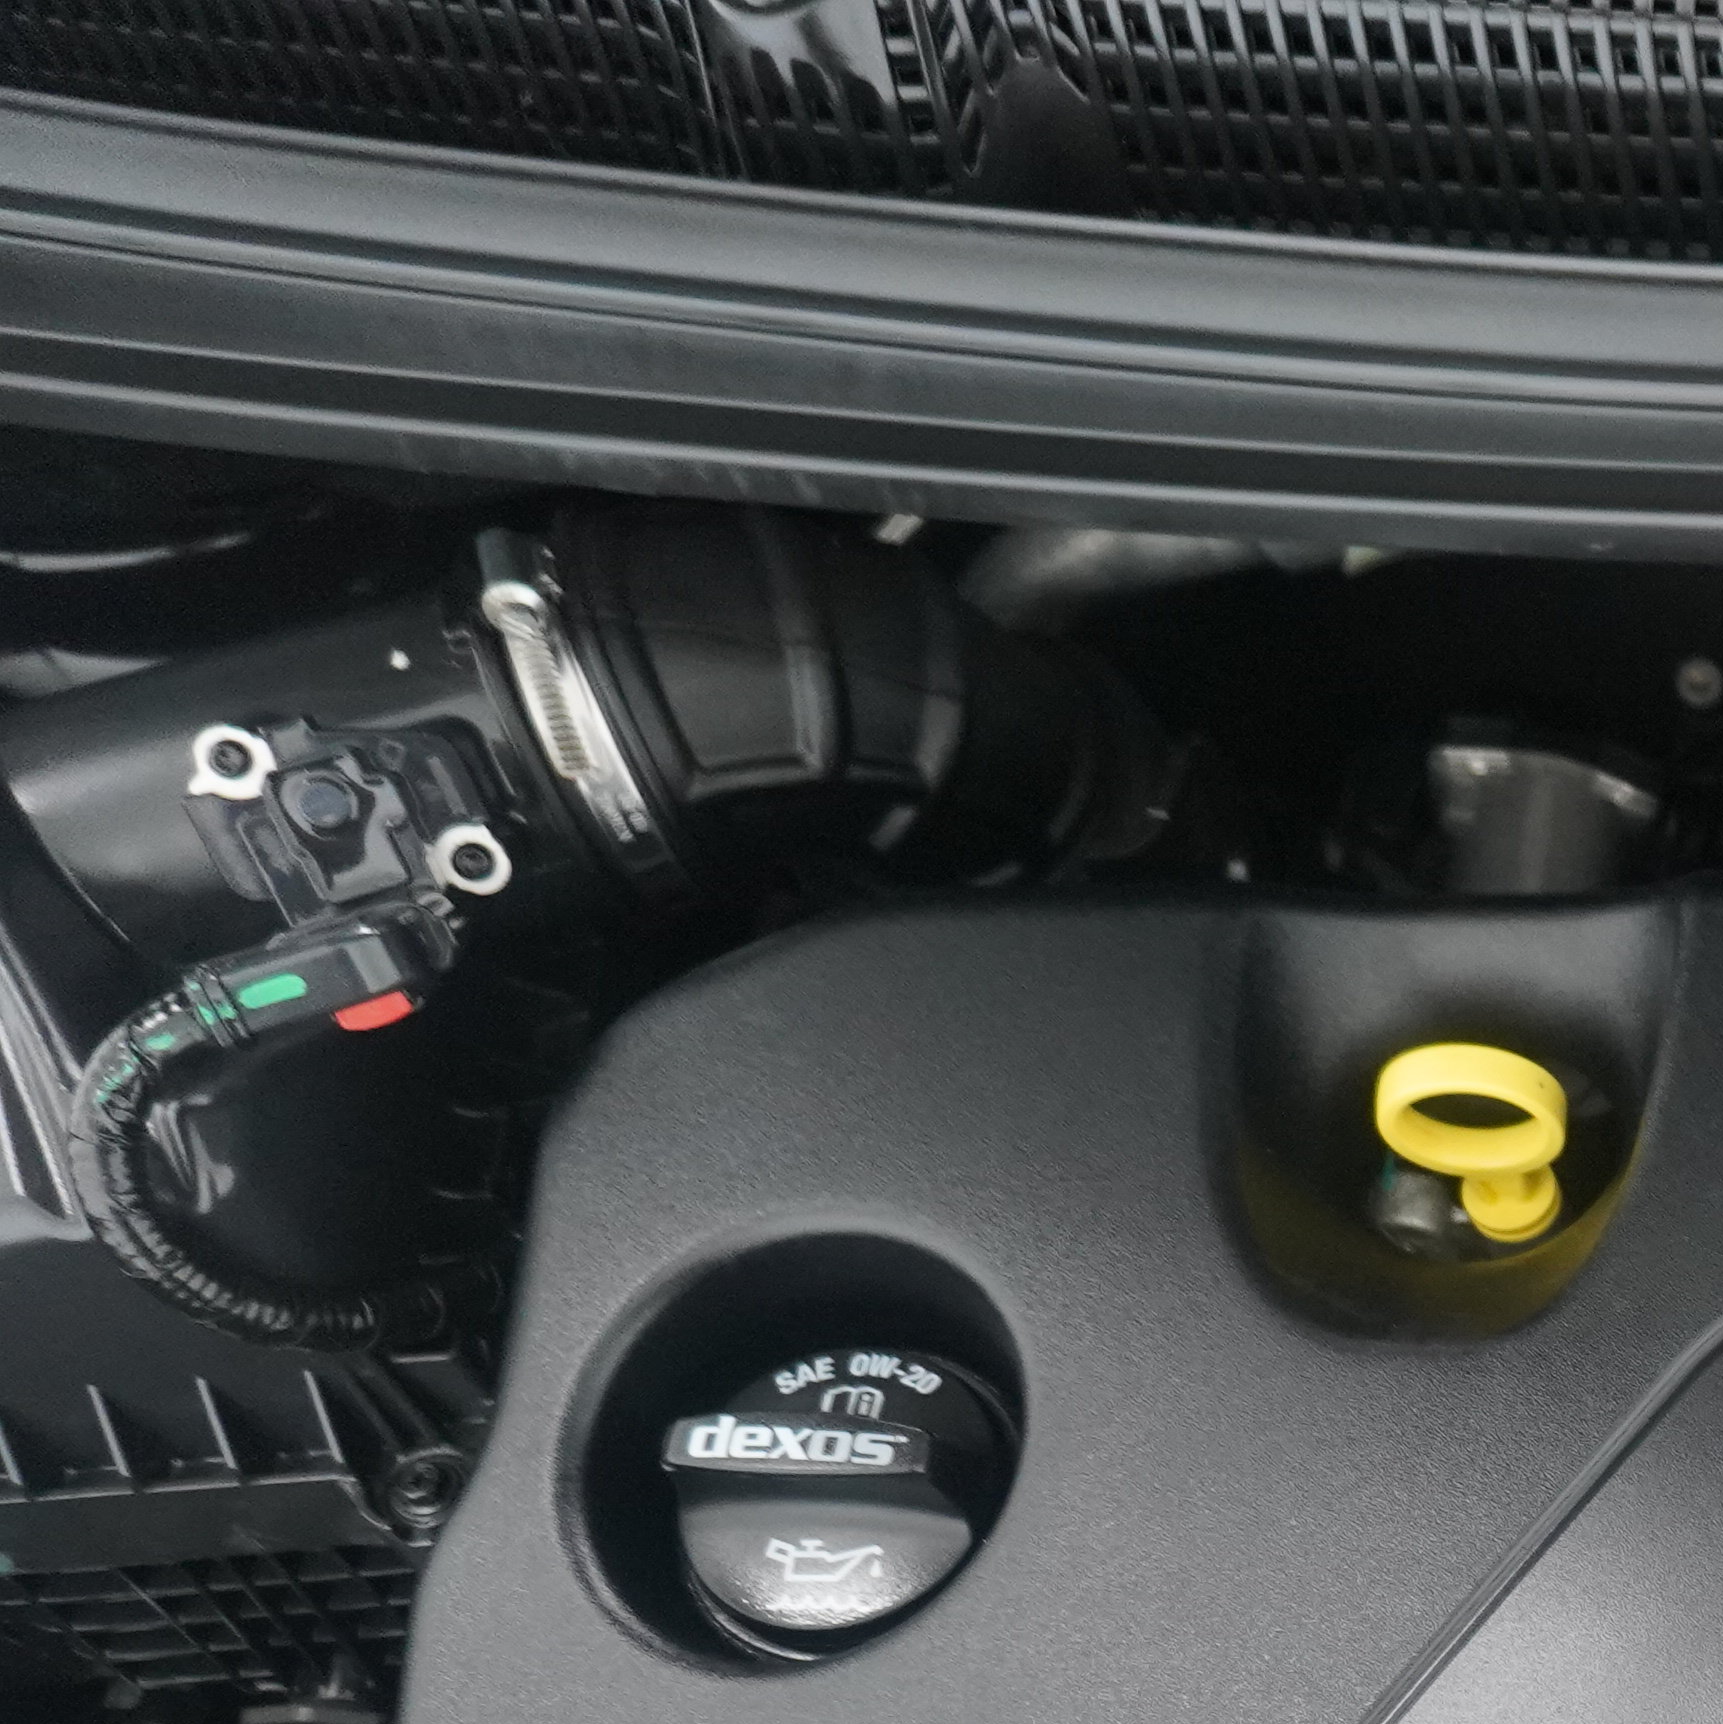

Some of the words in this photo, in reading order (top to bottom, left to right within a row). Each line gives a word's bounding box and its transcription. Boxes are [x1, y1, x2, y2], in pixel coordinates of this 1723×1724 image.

[775, 1356, 836, 1395] SAE
[848, 1352, 942, 1395] 0W-20
[687, 1415, 897, 1466] dexos
